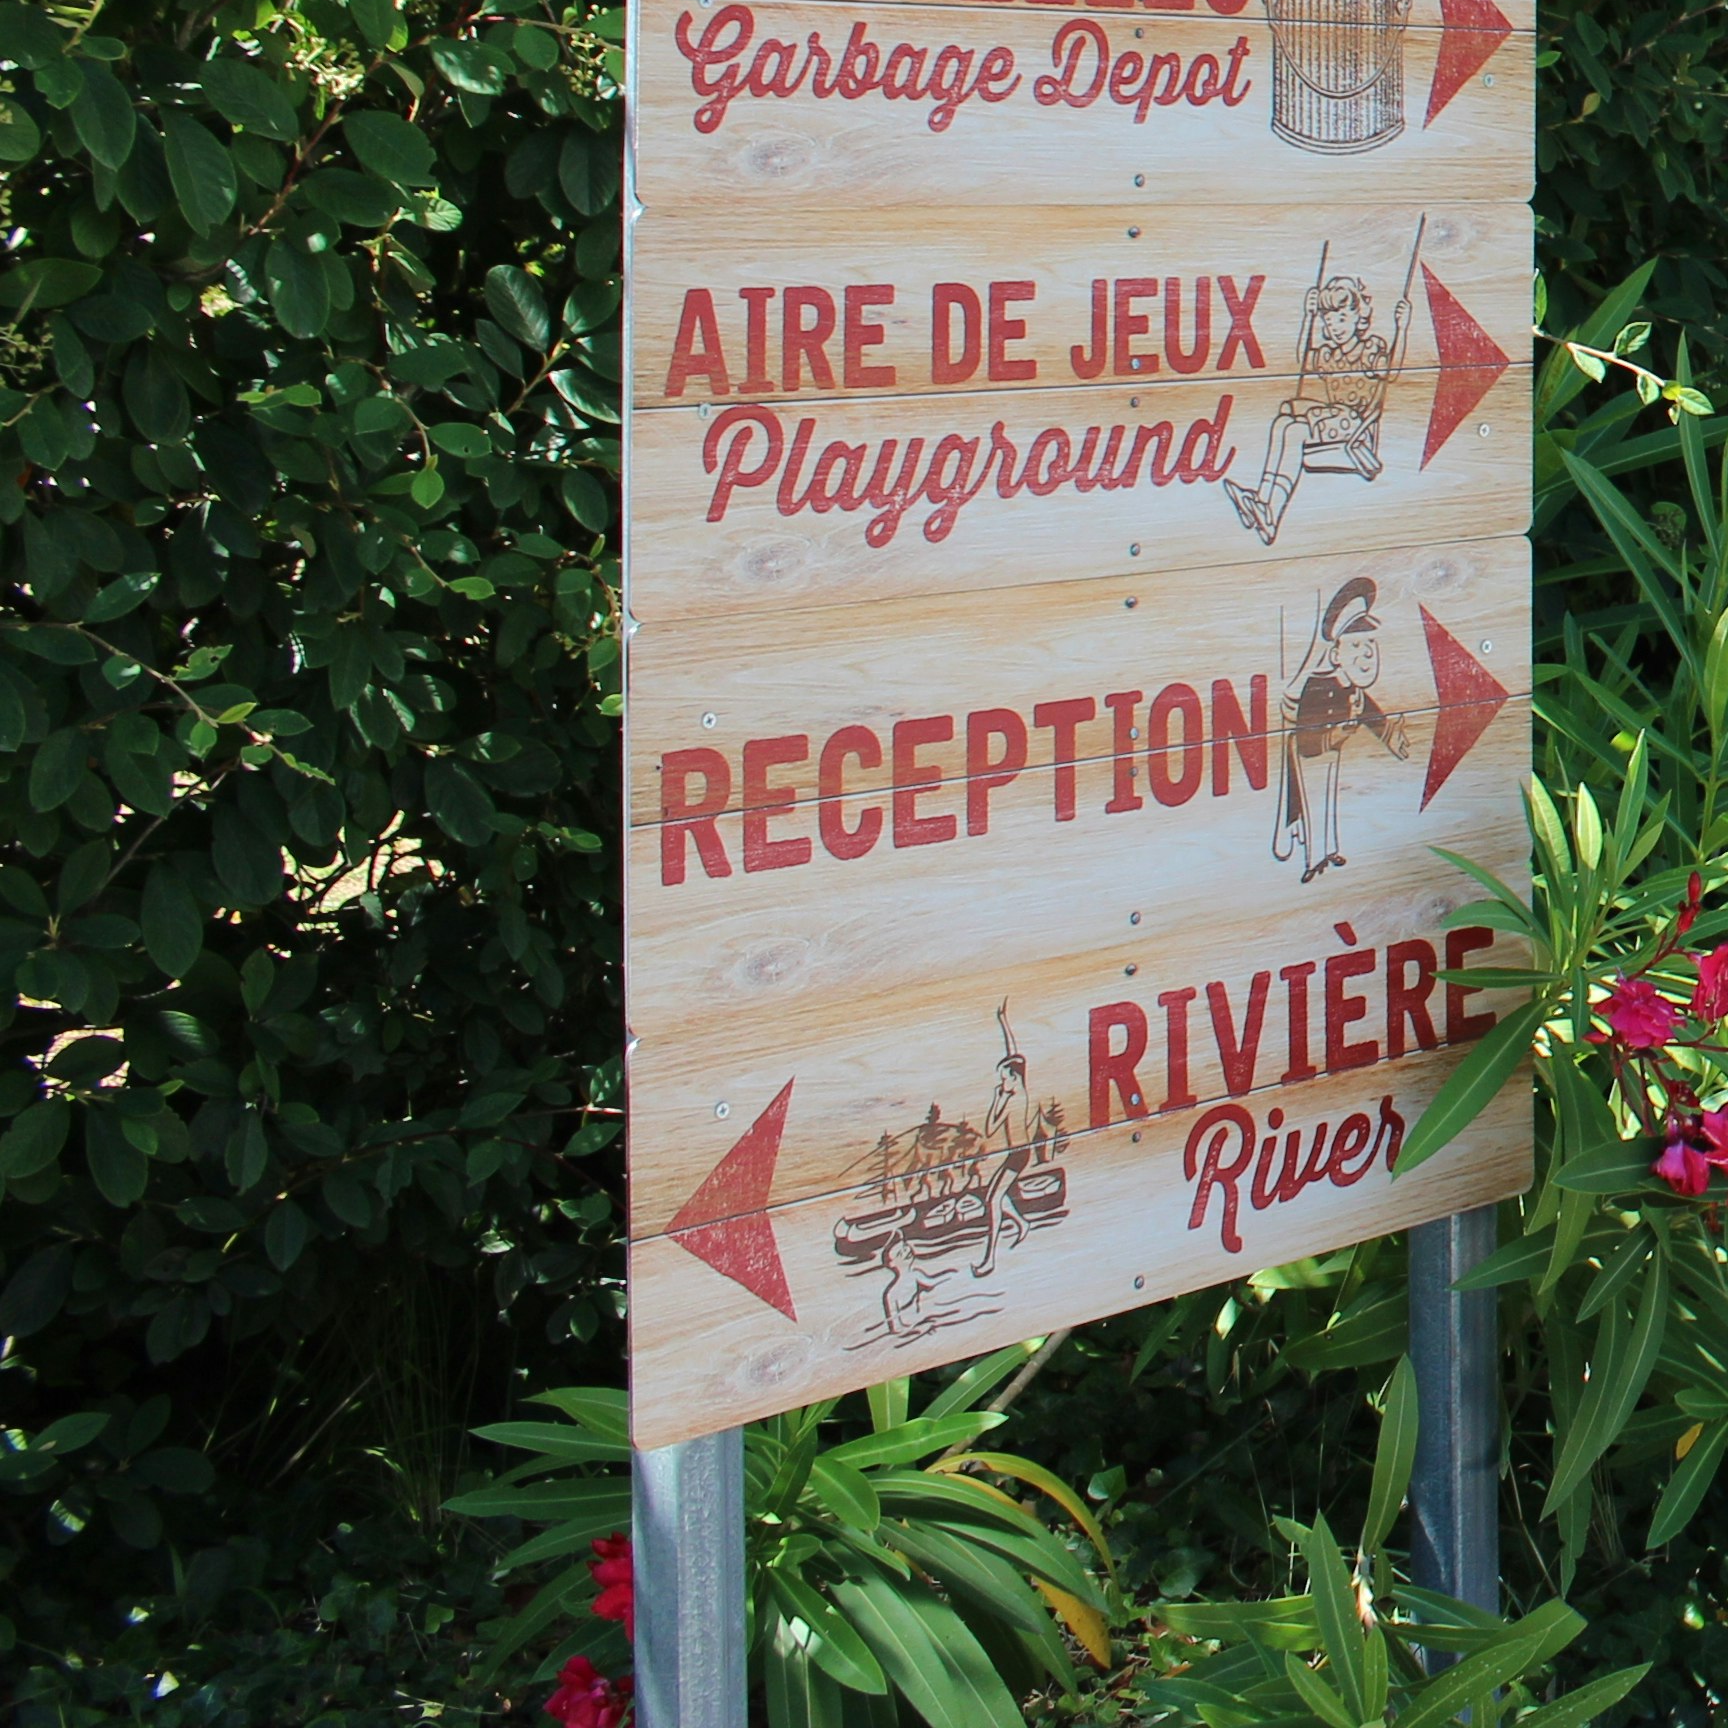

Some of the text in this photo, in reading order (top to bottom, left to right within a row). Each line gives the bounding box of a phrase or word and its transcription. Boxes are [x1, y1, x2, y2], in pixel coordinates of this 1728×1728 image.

[674, 4, 1252, 134] Garbage Depot
[663, 274, 1266, 398] AIRE DE JEUX
[702, 394, 1236, 548] Playground
[660, 674, 1268, 887] RECEPTION
[1088, 922, 1496, 1129] RIVIÈRE
[1184, 1094, 1405, 1255] River
